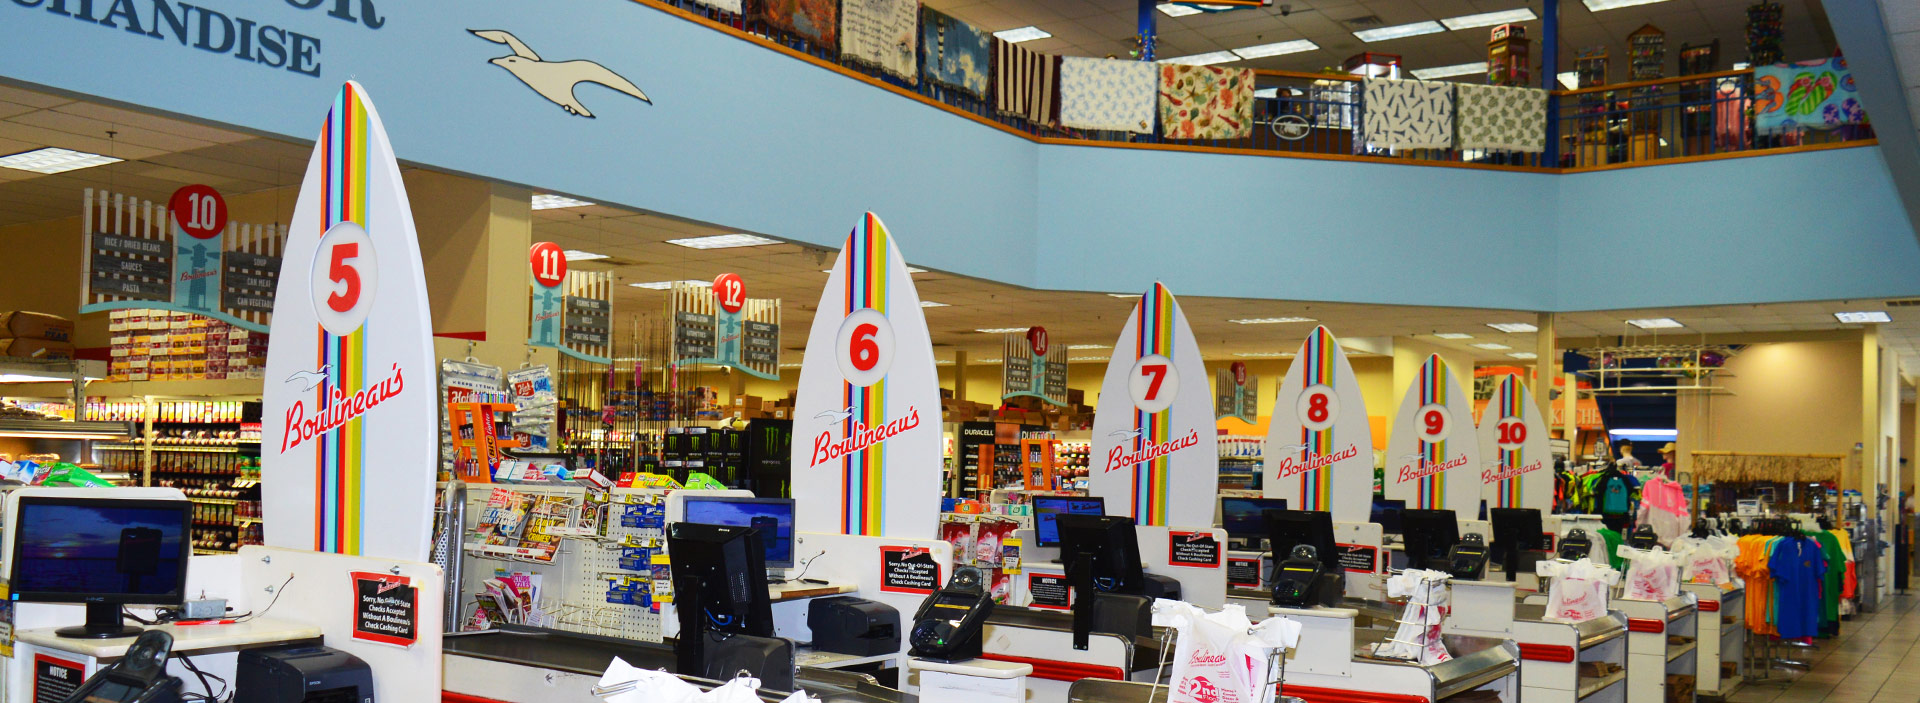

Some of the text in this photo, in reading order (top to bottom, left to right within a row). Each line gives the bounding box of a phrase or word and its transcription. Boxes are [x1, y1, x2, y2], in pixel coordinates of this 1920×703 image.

[10, 0, 321, 79] HANDISE
[187, 192, 217, 230] 10
[104, 237, 118, 247] RICE
[124, 240, 142, 251] DRIED
[142, 242, 161, 253] BEANS
[121, 261, 143, 273] SAUCES
[253, 257, 267, 268] SOUP
[540, 249, 560, 281] 11
[122, 283, 140, 294] PASTA
[247, 277, 272, 289] CAN MEAT
[328, 242, 362, 313] 5
[237, 297, 274, 309] CAN VEGETABL
[724, 279, 742, 307] 12
[849, 322, 880, 372] 6
[1035, 331, 1046, 352] 14
[517, 384, 532, 397] Hot
[534, 378, 548, 391] Cold
[1141, 363, 1168, 401] 7
[281, 363, 404, 455] Boulineau's
[1307, 392, 1329, 423] 8
[1551, 408, 1602, 426] KICHE
[964, 428, 994, 438] DURACELL
[1424, 409, 1445, 436] 9
[1497, 421, 1528, 445] 10
[487, 436, 496, 458] BIC
[811, 406, 920, 468] Boulineau's
[1105, 429, 1199, 473] Boulineau's
[1277, 444, 1358, 481] Boulineau's
[1397, 453, 1468, 485] Boulineau's
[1481, 458, 1542, 485] Boulineau's
[362, 612, 382, 621] Without
[386, 615, 411, 626] Boulineau's
[369, 604, 406, 616] Checks Accepted
[365, 621, 409, 634] Check Cashing Card
[49, 665, 68, 680] NOTICE
